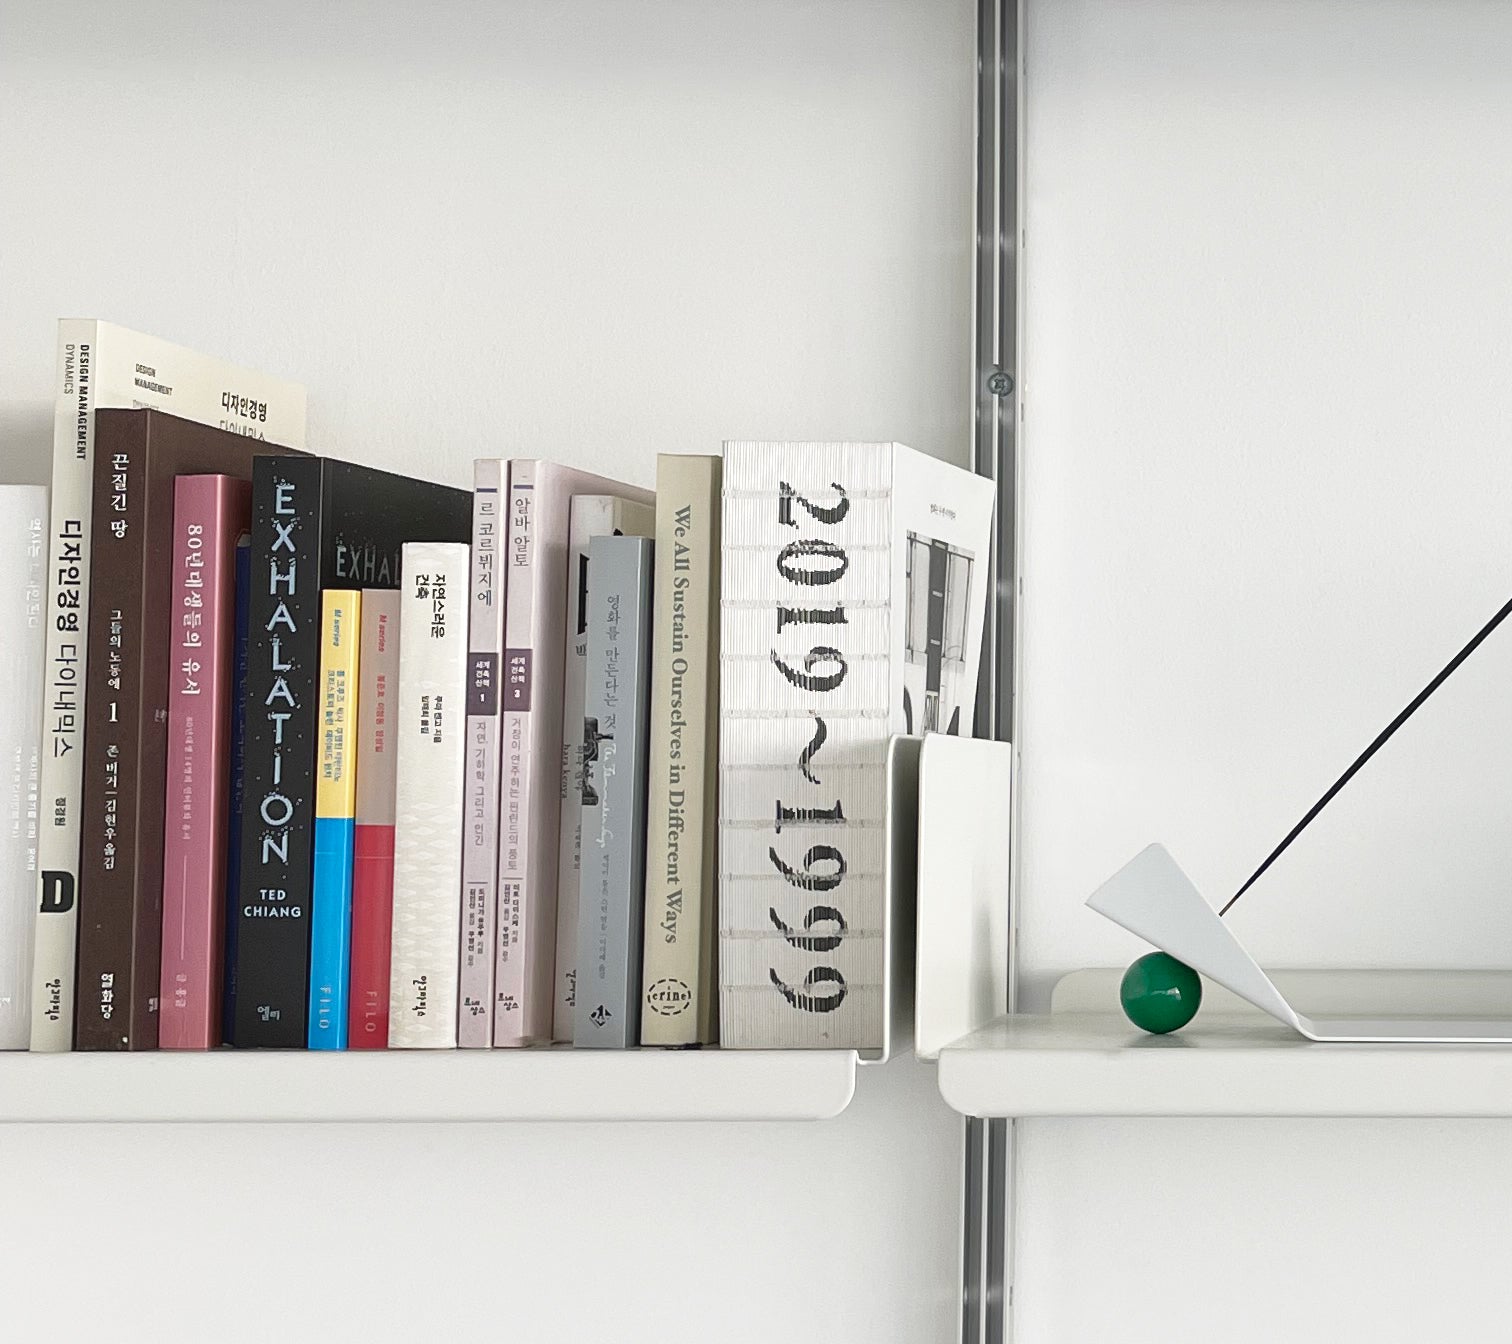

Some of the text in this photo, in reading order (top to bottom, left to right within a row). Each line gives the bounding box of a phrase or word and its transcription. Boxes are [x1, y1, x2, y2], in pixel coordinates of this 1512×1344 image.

[64, 344, 75, 394] DYNAMICS
[77, 345, 89, 459] DESIGN MANAGEMENT
[57, 521, 82, 631] 디자인경영
[182, 525, 204, 694] 80년대생들의 유서
[416, 575, 429, 599] 건축
[431, 574, 446, 638] 자연스러운
[53, 645, 77, 757] 다이내믹스
[261, 483, 298, 865] EXHALATION
[661, 505, 690, 943] We All Sustain Ourselves in Different Ways
[245, 906, 300, 917] CHIANG
[260, 890, 285, 900] TED
[365, 991, 377, 1033] FILO
